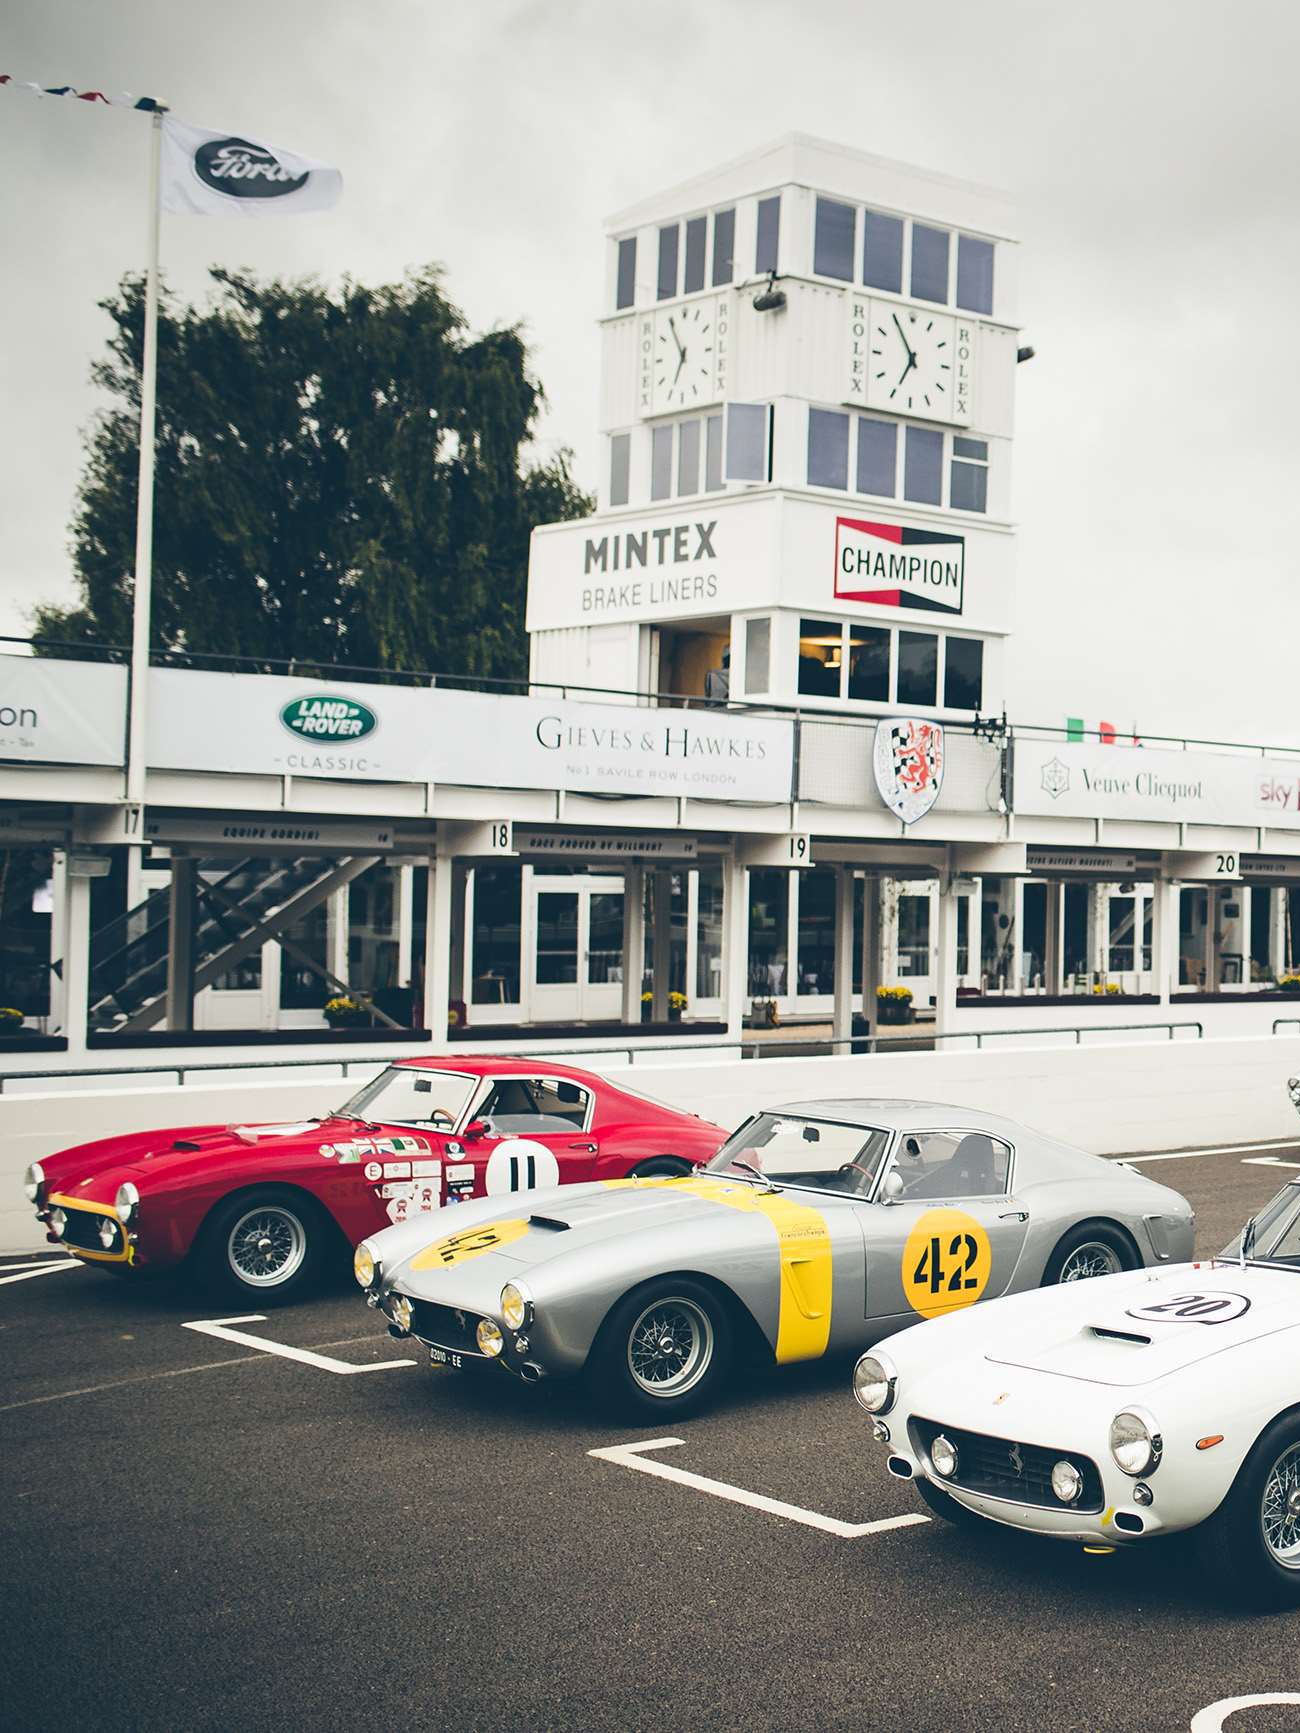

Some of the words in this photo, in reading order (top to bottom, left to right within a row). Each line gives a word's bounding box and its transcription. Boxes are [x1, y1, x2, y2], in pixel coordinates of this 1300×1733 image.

[718, 303, 728, 390] ROLEX
[852, 304, 864, 393] ROLEX
[642, 322, 651, 406] ROLEX
[957, 328, 969, 413] ROLEX
[584, 520, 717, 575] MINTEX
[842, 547, 958, 588] CHAMPION
[582, 583, 642, 611] BRAKE
[650, 574, 717, 604] LINERS
[0, 707, 37, 727] on
[299, 700, 348, 718] LAND
[302, 717, 363, 735] ROVER
[640, 732, 654, 752] &
[287, 755, 367, 771] CLASSIC
[597, 767, 643, 779] SAVILE
[649, 769, 677, 781] ROW
[683, 772, 736, 785] LONDON
[1082, 768, 1130, 794] Veuve
[1135, 773, 1202, 803] Clicquot
[1260, 780, 1291, 809] sky
[124, 808, 140, 834] 17
[492, 824, 508, 848] 18
[789, 837, 806, 858] 19
[1216, 855, 1235, 872] 20
[510, 1155, 536, 1193] 11
[913, 1233, 978, 1294] 42
[1141, 1295, 1231, 1316] 20
[452, 1354, 462, 1368] EE
